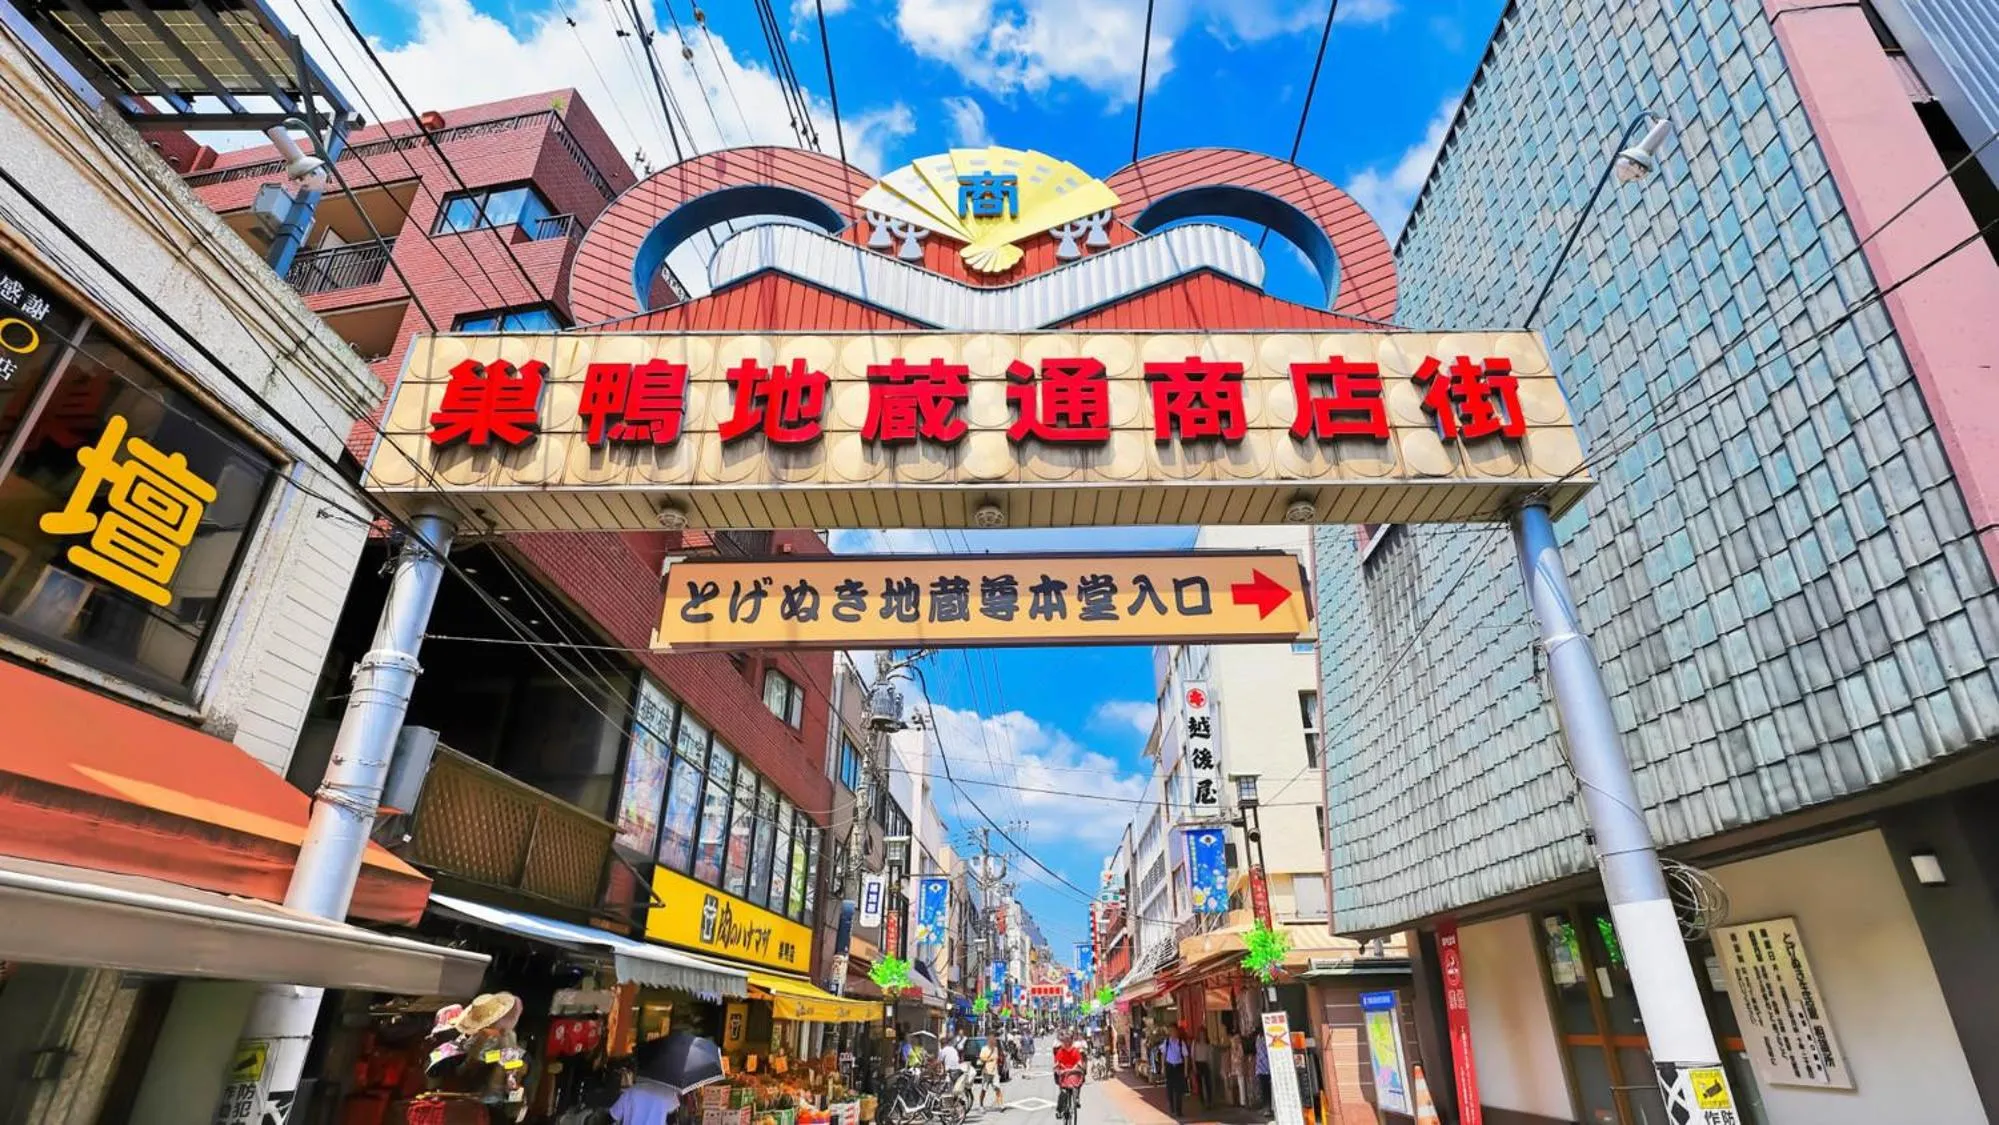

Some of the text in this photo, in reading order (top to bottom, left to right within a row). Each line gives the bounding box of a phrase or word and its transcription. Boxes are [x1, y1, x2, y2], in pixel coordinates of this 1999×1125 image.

[957, 170, 1019, 217] 商
[0, 276, 50, 320] 感謝
[428, 357, 1528, 446] 巣鴨地蔵通商店街
[39, 415, 217, 607] 壇
[680, 573, 1214, 625] とげぬき地蔵尊本堂入口
[1188, 716, 1218, 804] 越後屋
